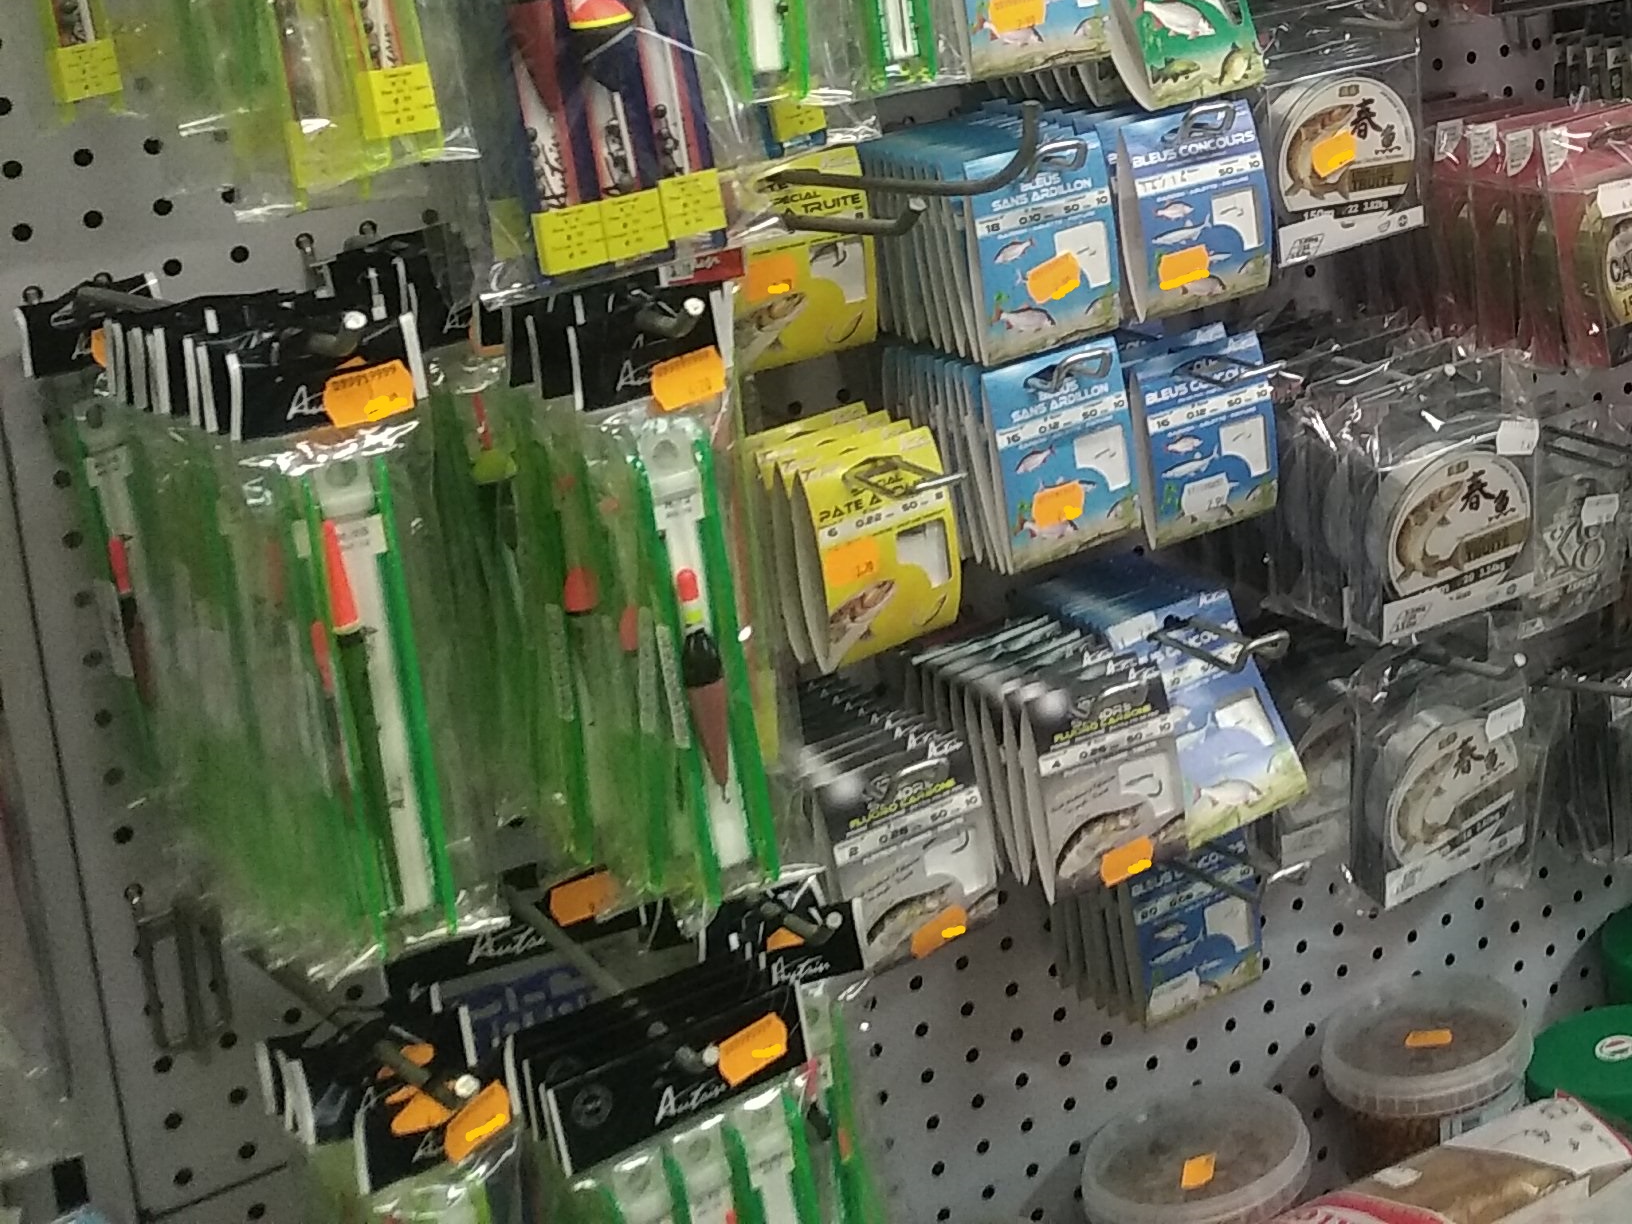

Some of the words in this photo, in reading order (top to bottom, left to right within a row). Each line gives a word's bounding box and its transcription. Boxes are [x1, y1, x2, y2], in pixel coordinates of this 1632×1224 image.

[1132, 149, 1177, 169] BLEUS
[1180, 130, 1256, 157] CONCOURS
[1218, 167, 1233, 176] 50
[1248, 160, 1260, 168] 10
[1020, 173, 1061, 191] BLEUS
[801, 192, 862, 213] TRUITE
[992, 195, 1027, 211] SANS
[1031, 178, 1092, 202] ARDILLON
[1063, 203, 1080, 213] 50
[1096, 195, 1108, 205] 10
[1011, 407, 1047, 422] SANS
[1050, 384, 1110, 407] ARDILLON
[1145, 383, 1189, 406] BLEUS
[1082, 409, 1098, 420] 50
[1113, 399, 1125, 408] 10
[818, 500, 864, 524] PATE
